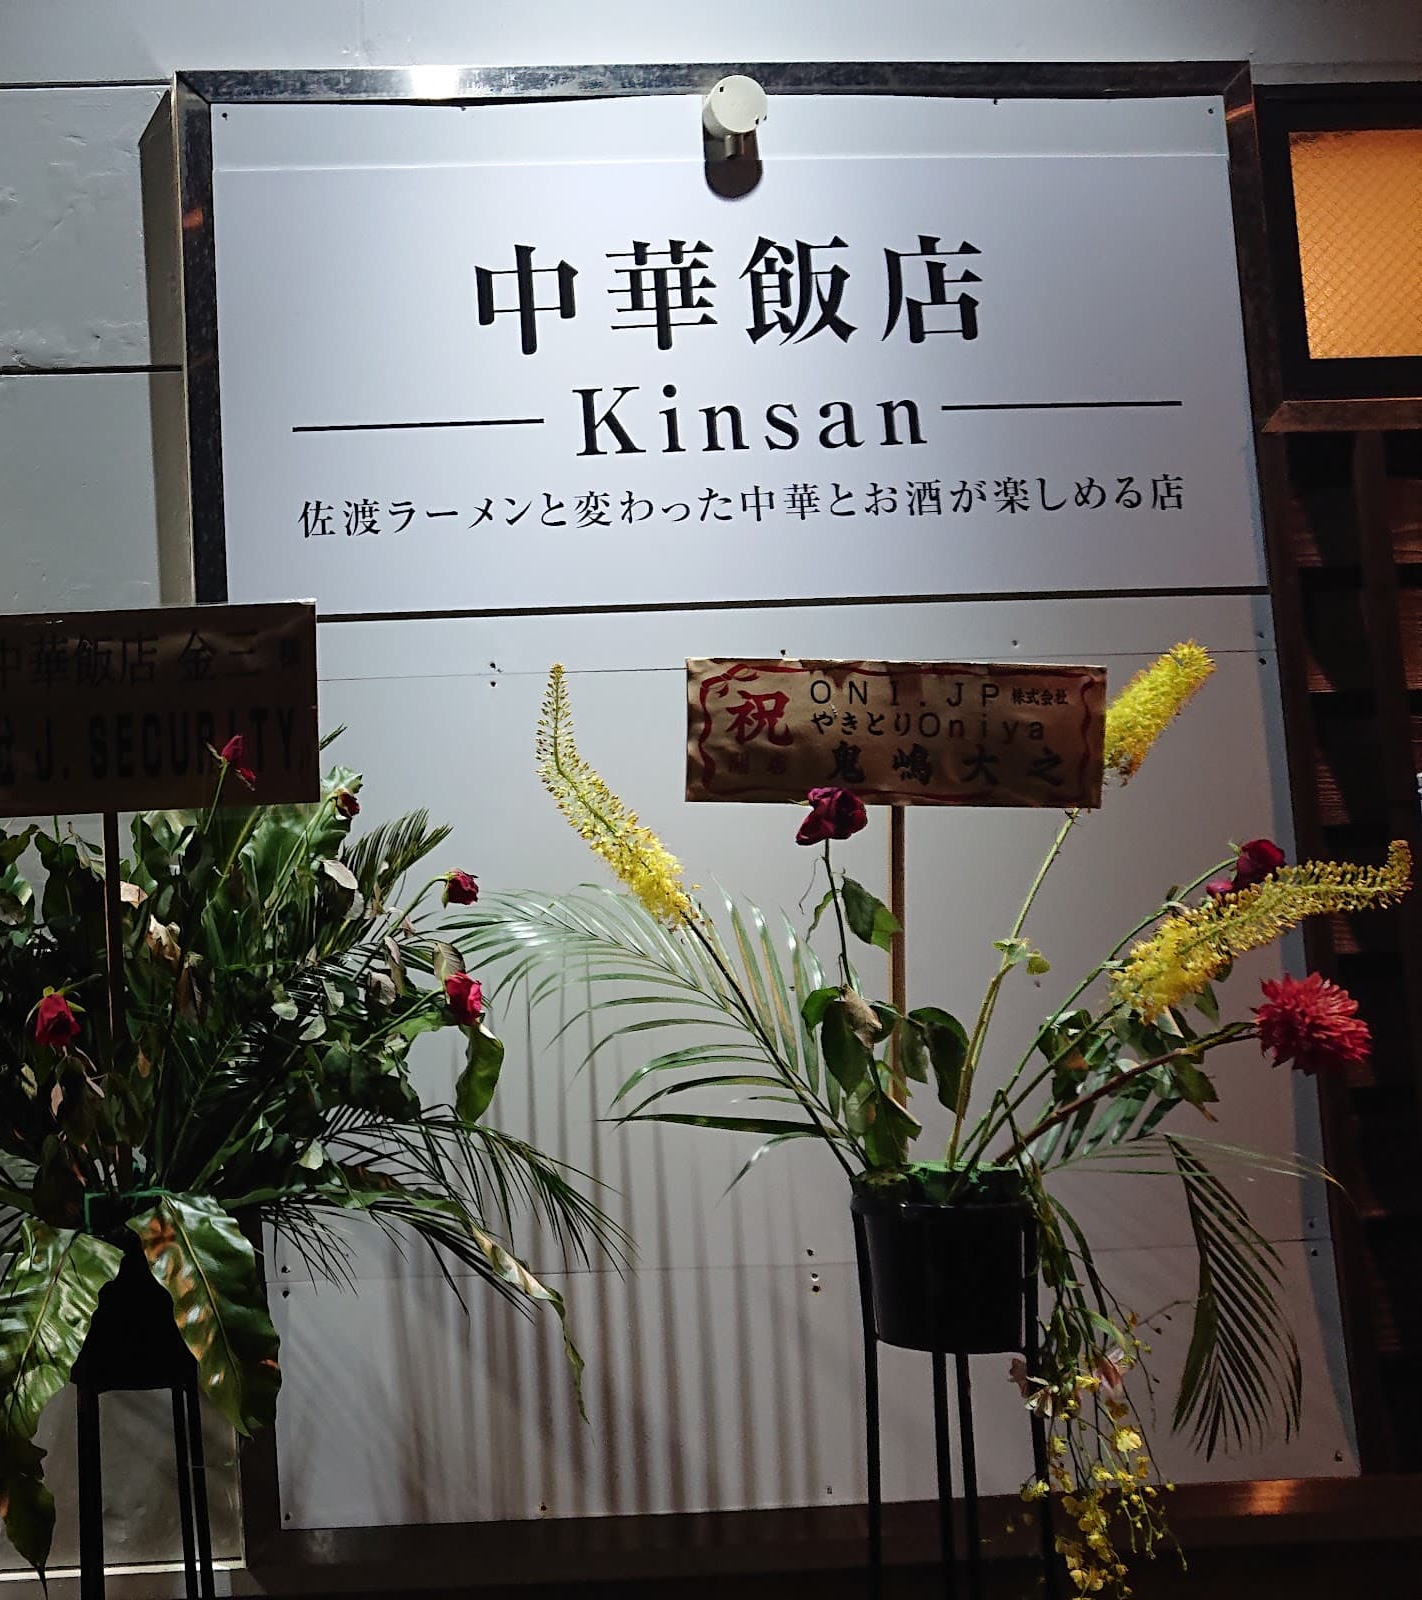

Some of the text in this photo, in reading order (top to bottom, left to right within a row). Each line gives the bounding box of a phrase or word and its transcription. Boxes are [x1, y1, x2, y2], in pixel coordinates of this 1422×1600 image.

[474, 234, 985, 356] 中華飯店
[576, 384, 929, 457] Kinsan
[297, 474, 1187, 541] 佐渡ラーメンと変わった中華とお酒が楽しめる店
[725, 690, 793, 748] 祝
[1010, 686, 1071, 708] 株式会社
